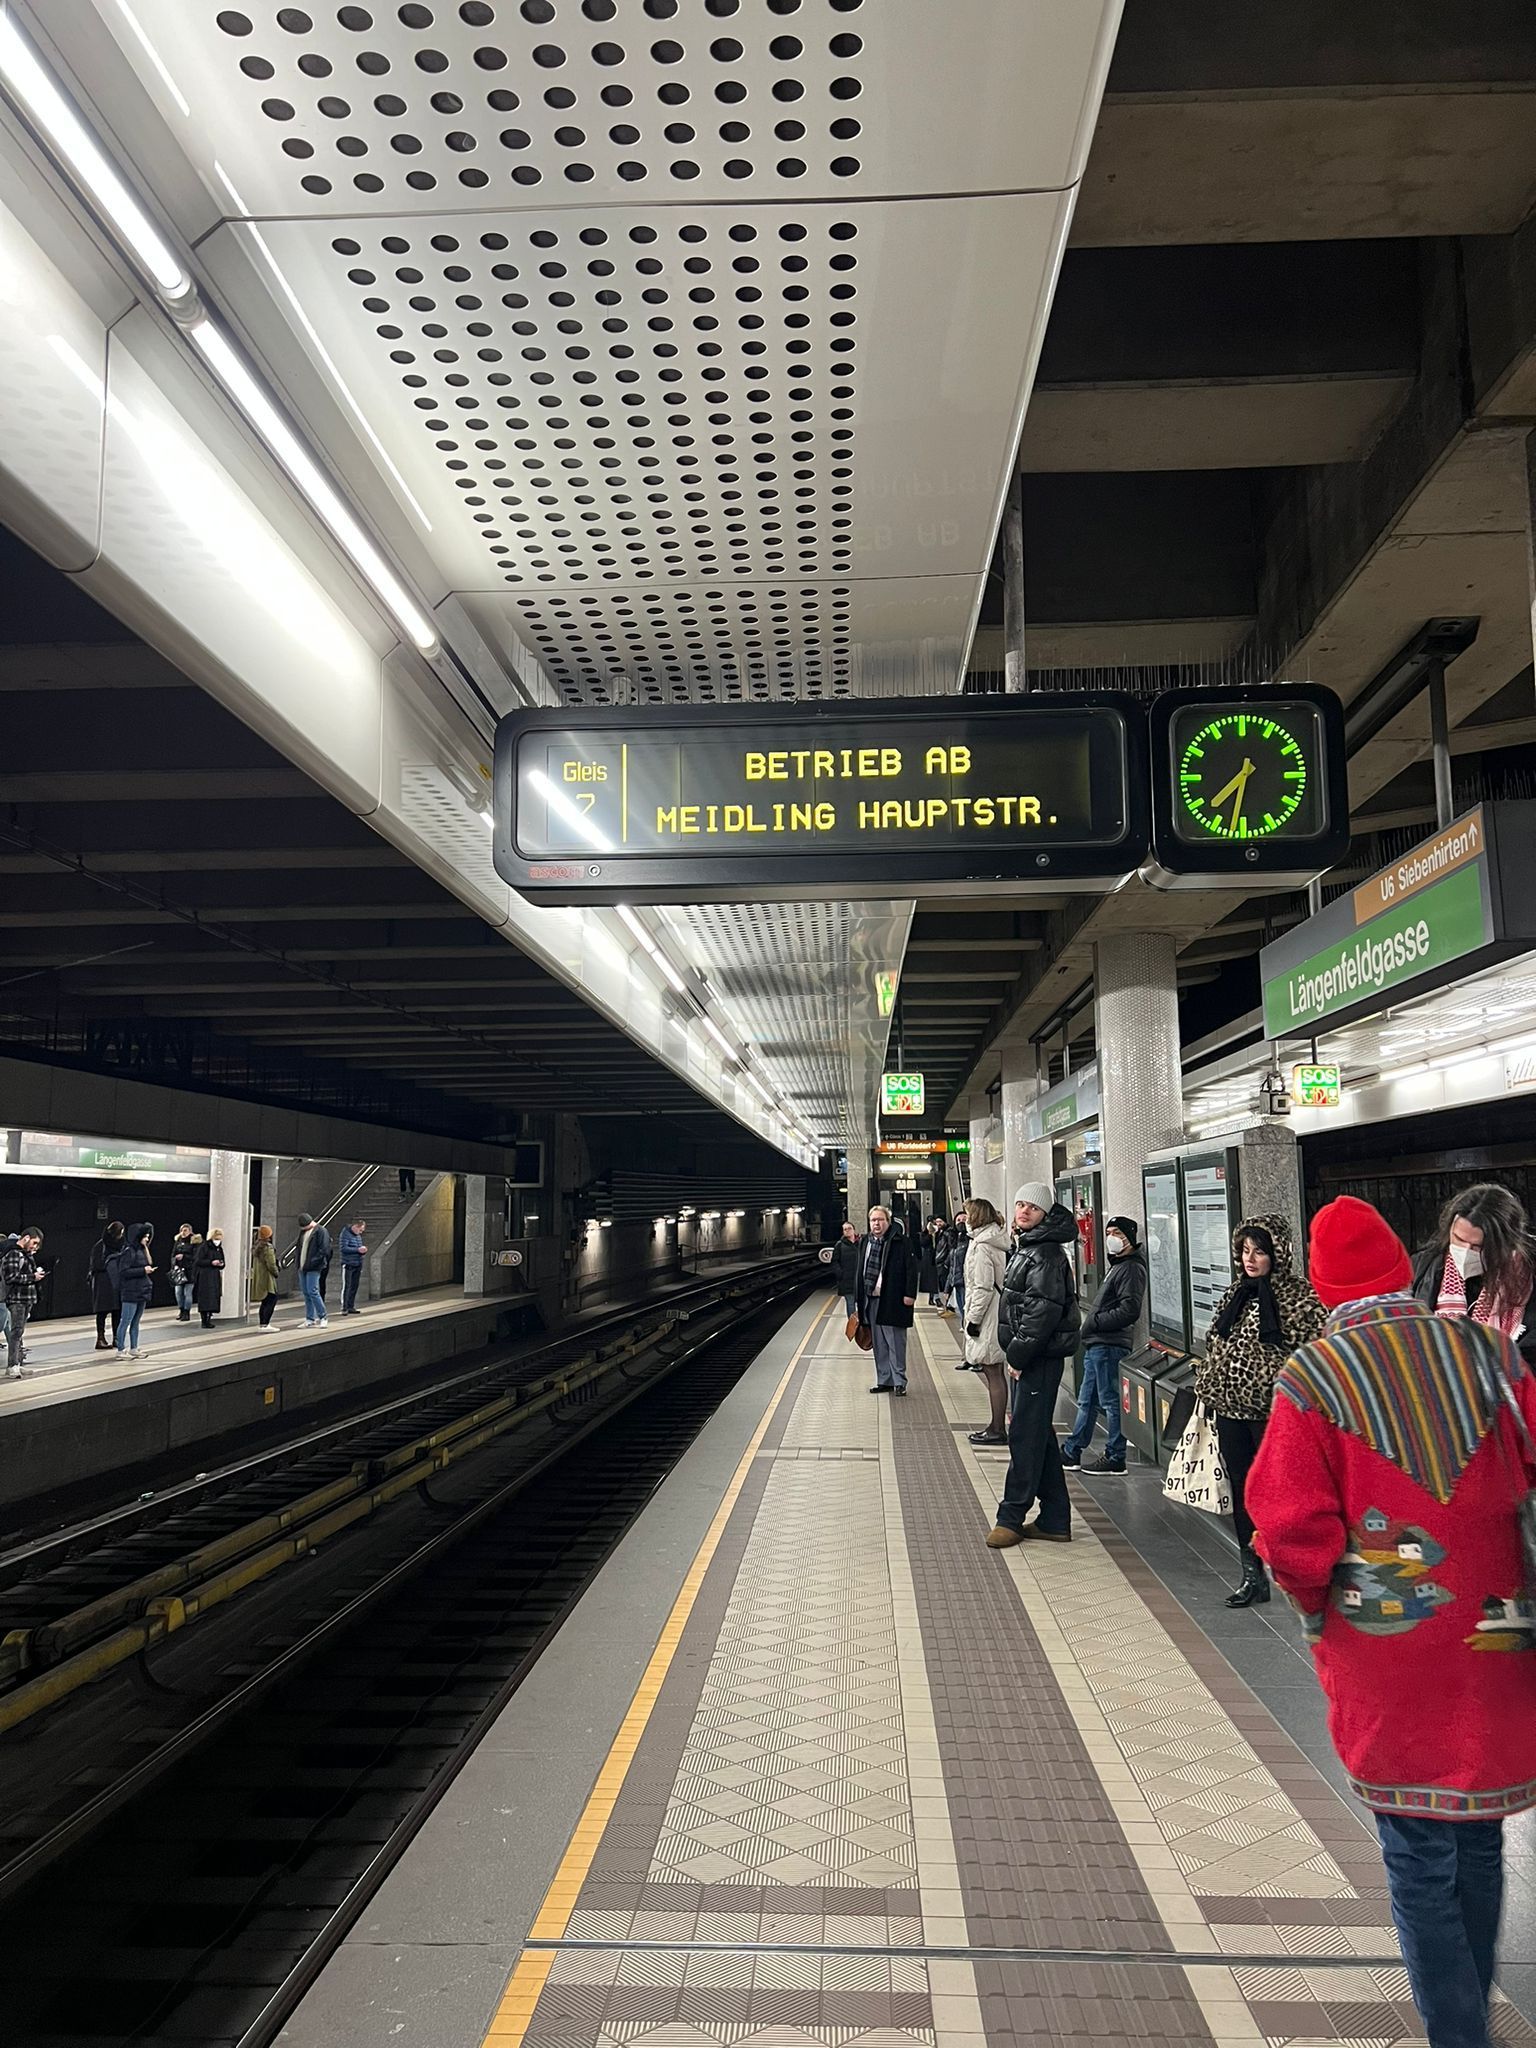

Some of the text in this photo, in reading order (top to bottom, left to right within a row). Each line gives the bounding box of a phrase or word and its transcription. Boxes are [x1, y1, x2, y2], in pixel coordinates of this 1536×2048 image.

[563, 761, 608, 782] Gleis
[745, 745, 972, 782] BETRIEB AB
[656, 796, 1059, 835] MEIDLING HAUPTSTR.
[1380, 834, 1469, 901] U6 Siebenhirten
[1289, 919, 1430, 1017] Längenfeldgasse
[887, 1077, 921, 1091] SOS
[1302, 1069, 1337, 1084] SOS
[1184, 1487, 1209, 1504] 1971
